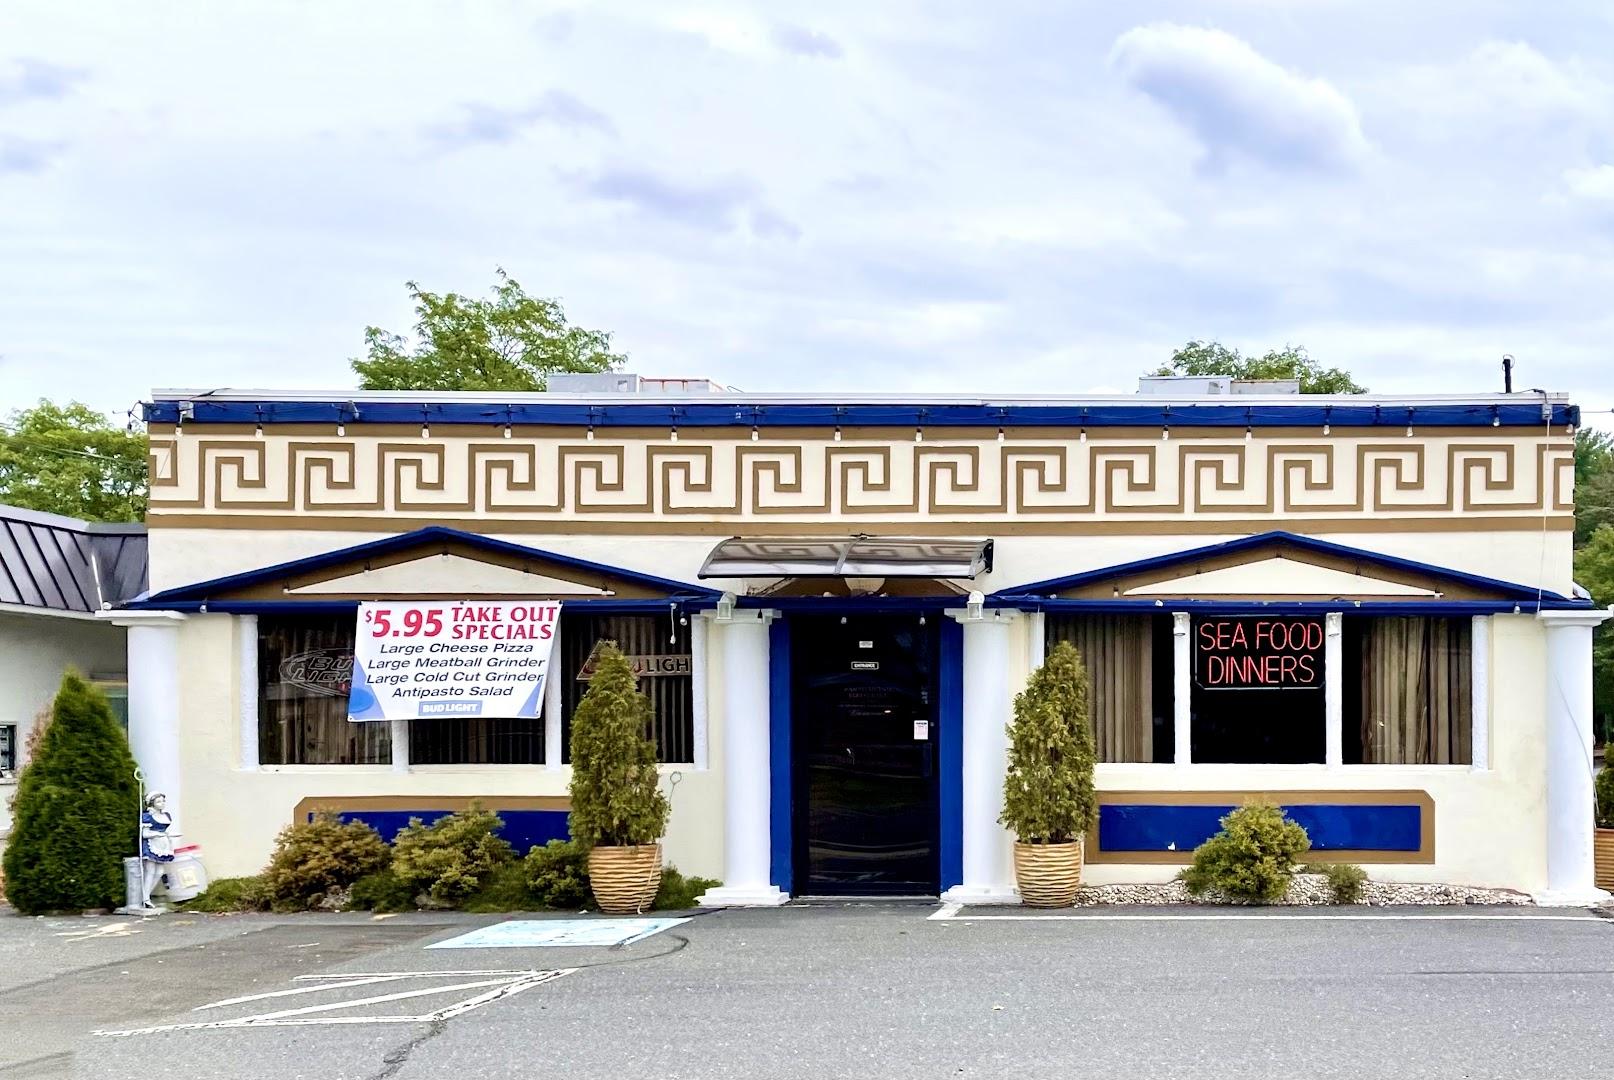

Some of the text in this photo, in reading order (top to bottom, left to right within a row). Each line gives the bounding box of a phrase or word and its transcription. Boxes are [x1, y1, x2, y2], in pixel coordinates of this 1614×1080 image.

[452, 607, 557, 622] TAKE OUT
[365, 609, 443, 637] $5.95
[452, 624, 552, 640] SPECIALS
[1200, 622, 1322, 650] SEA FOOD
[380, 643, 533, 655] Large Cheese Pizza
[308, 656, 353, 670] BU
[368, 657, 546, 670] Large Meatball Grinder
[647, 658, 689, 673] LIGH
[1208, 654, 1315, 684] DINNERS
[366, 671, 544, 686] Large Cold Cut Grinder
[392, 686, 513, 699] Antipasto Salad
[422, 703, 478, 713] BUD LIGHT
